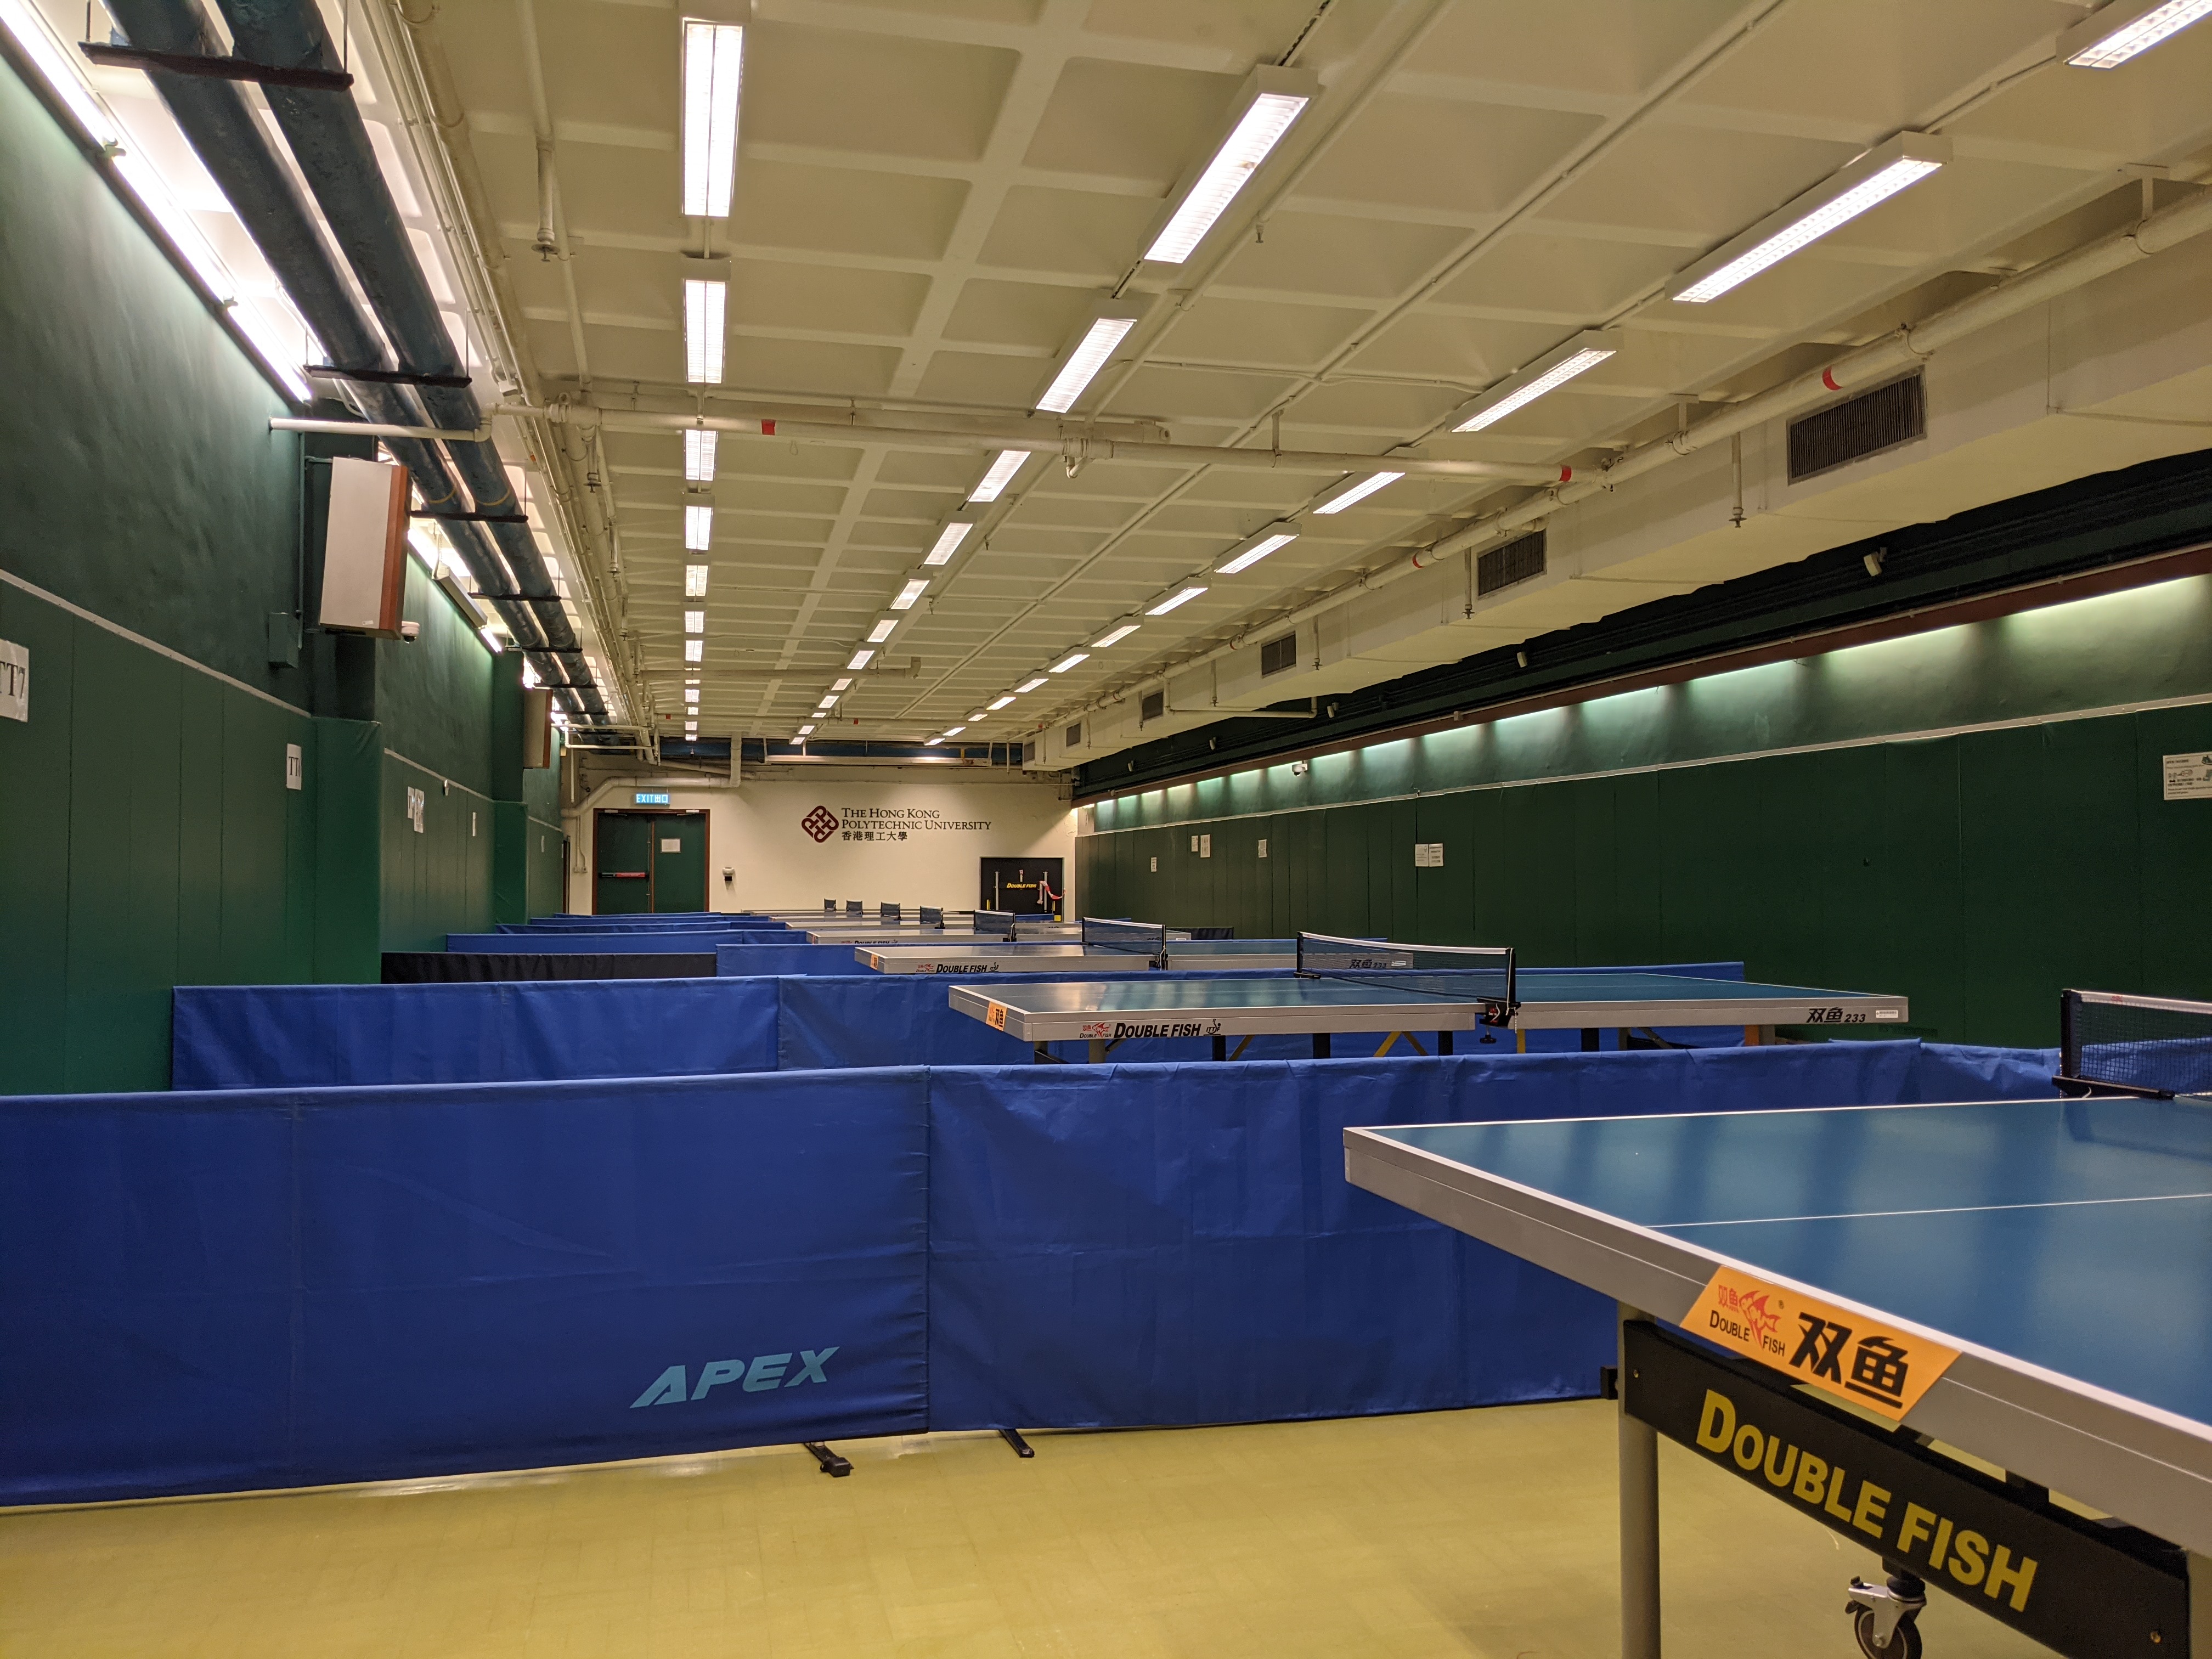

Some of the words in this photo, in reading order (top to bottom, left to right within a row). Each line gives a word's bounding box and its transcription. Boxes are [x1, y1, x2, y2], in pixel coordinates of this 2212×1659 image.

[636, 794, 653, 803] EXIT
[842, 808, 866, 818] THE
[869, 808, 905, 819] HONG
[907, 809, 940, 819] KONG
[842, 820, 922, 830] POLYTECHNIC
[924, 820, 991, 830] UNIVERSITY
[842, 831, 907, 841] 香港理工大學
[936, 964, 969, 973] DOUBLE
[969, 964, 988, 973] FISH
[1806, 1007, 1843, 1023] 双鱼
[1844, 1014, 1866, 1023] 233
[1114, 1023, 1170, 1039] DOUBLE
[1171, 1024, 1201, 1036] FISH
[1709, 1310, 1750, 1342] DOUBLE
[1763, 1335, 1785, 1357] FISH
[1788, 1312, 1909, 1409] 双鱼
[630, 1346, 840, 1408] APEX
[1696, 1389, 1891, 1538] DOUBLE
[1897, 1502, 2038, 1612] FISH
